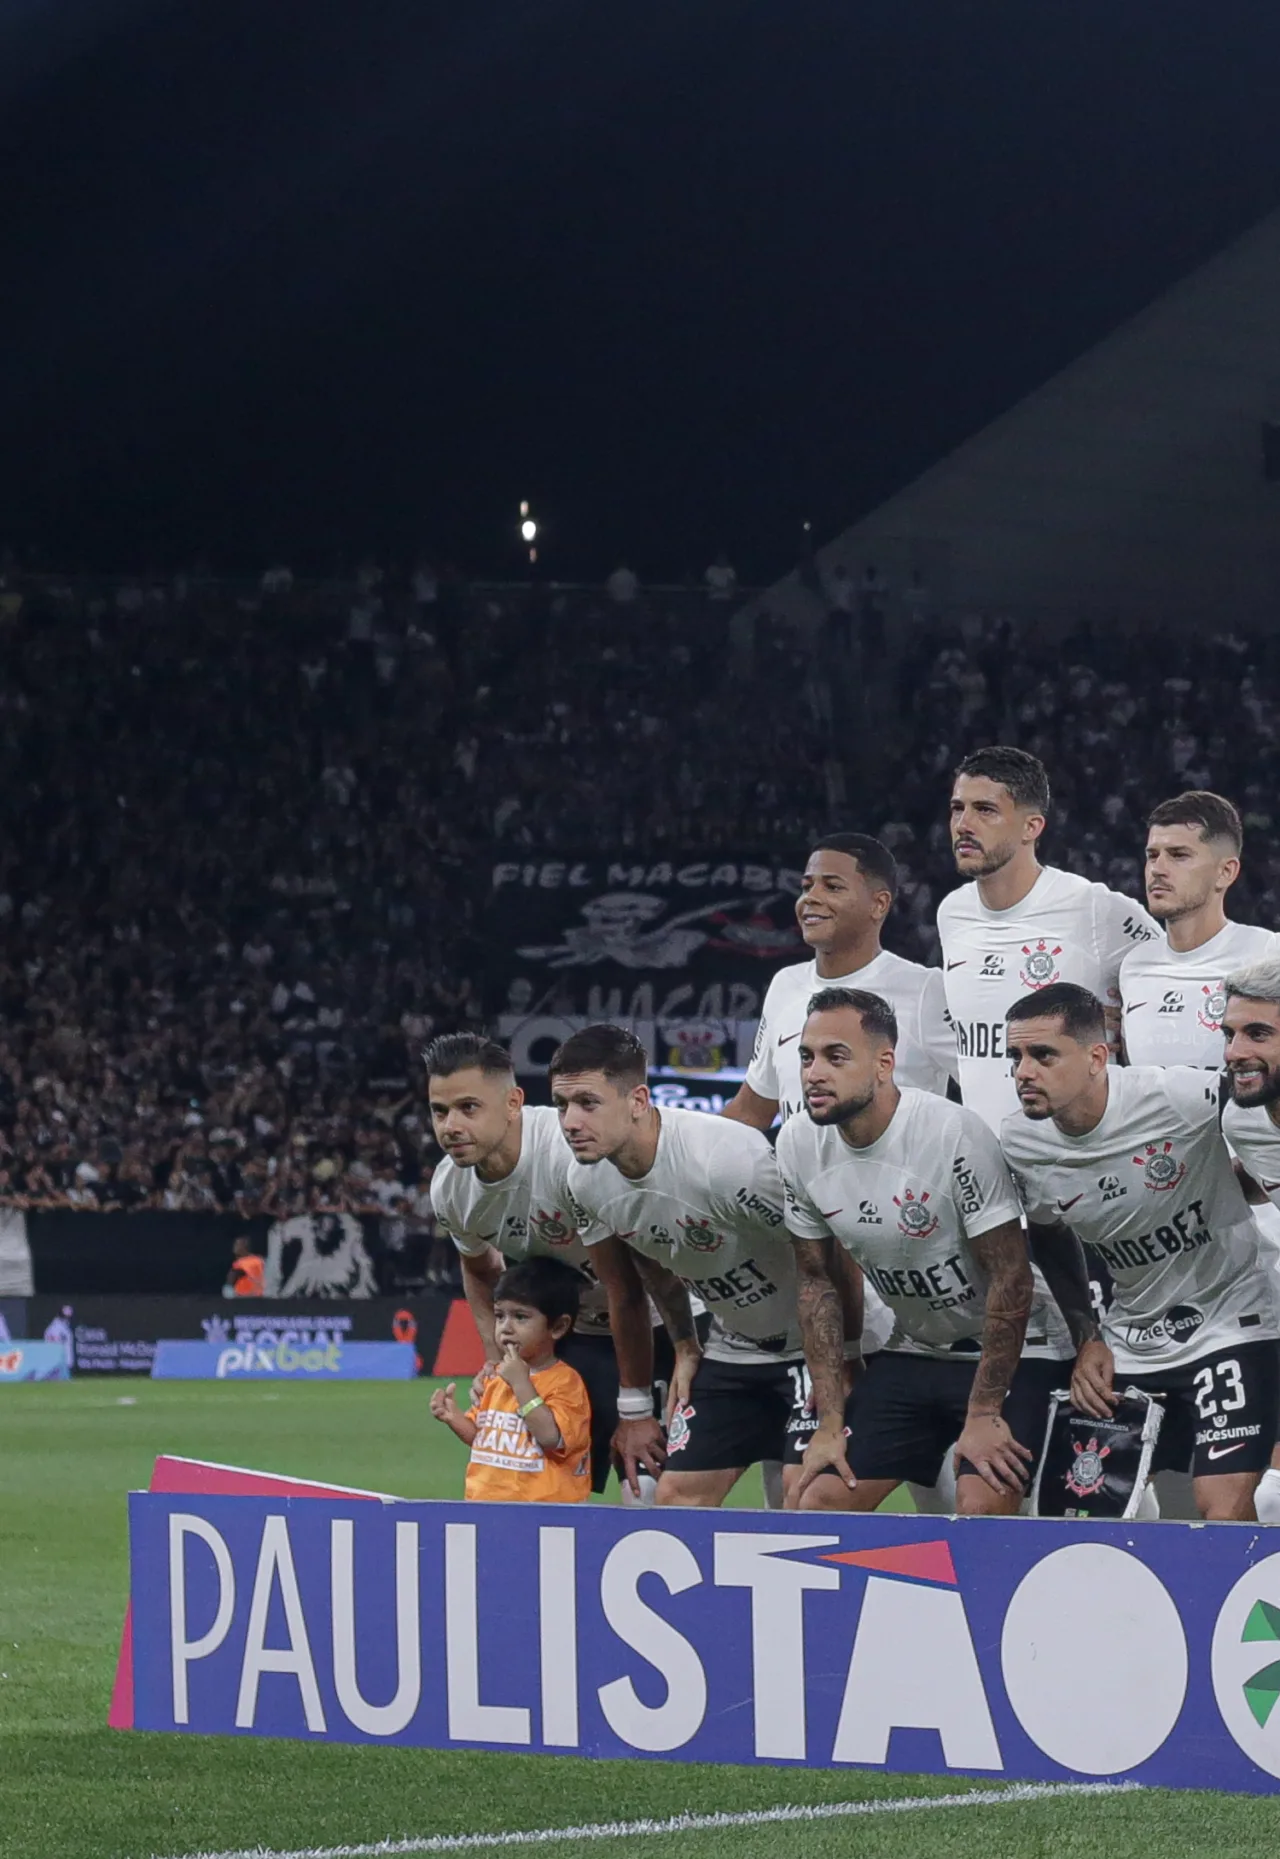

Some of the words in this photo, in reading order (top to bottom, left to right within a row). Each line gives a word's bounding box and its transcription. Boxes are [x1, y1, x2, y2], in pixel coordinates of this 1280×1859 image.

[492, 862, 591, 888] FIEL
[980, 967, 1006, 976] ALE
[1156, 1004, 1185, 1014] ALE
[955, 1167, 982, 1215] bmg
[1101, 1187, 1128, 1203] ALE
[745, 1193, 785, 1228] bmg
[857, 1215, 883, 1225] ALE
[215, 1342, 344, 1378] pixbet
[1192, 1358, 1247, 1419] 23
